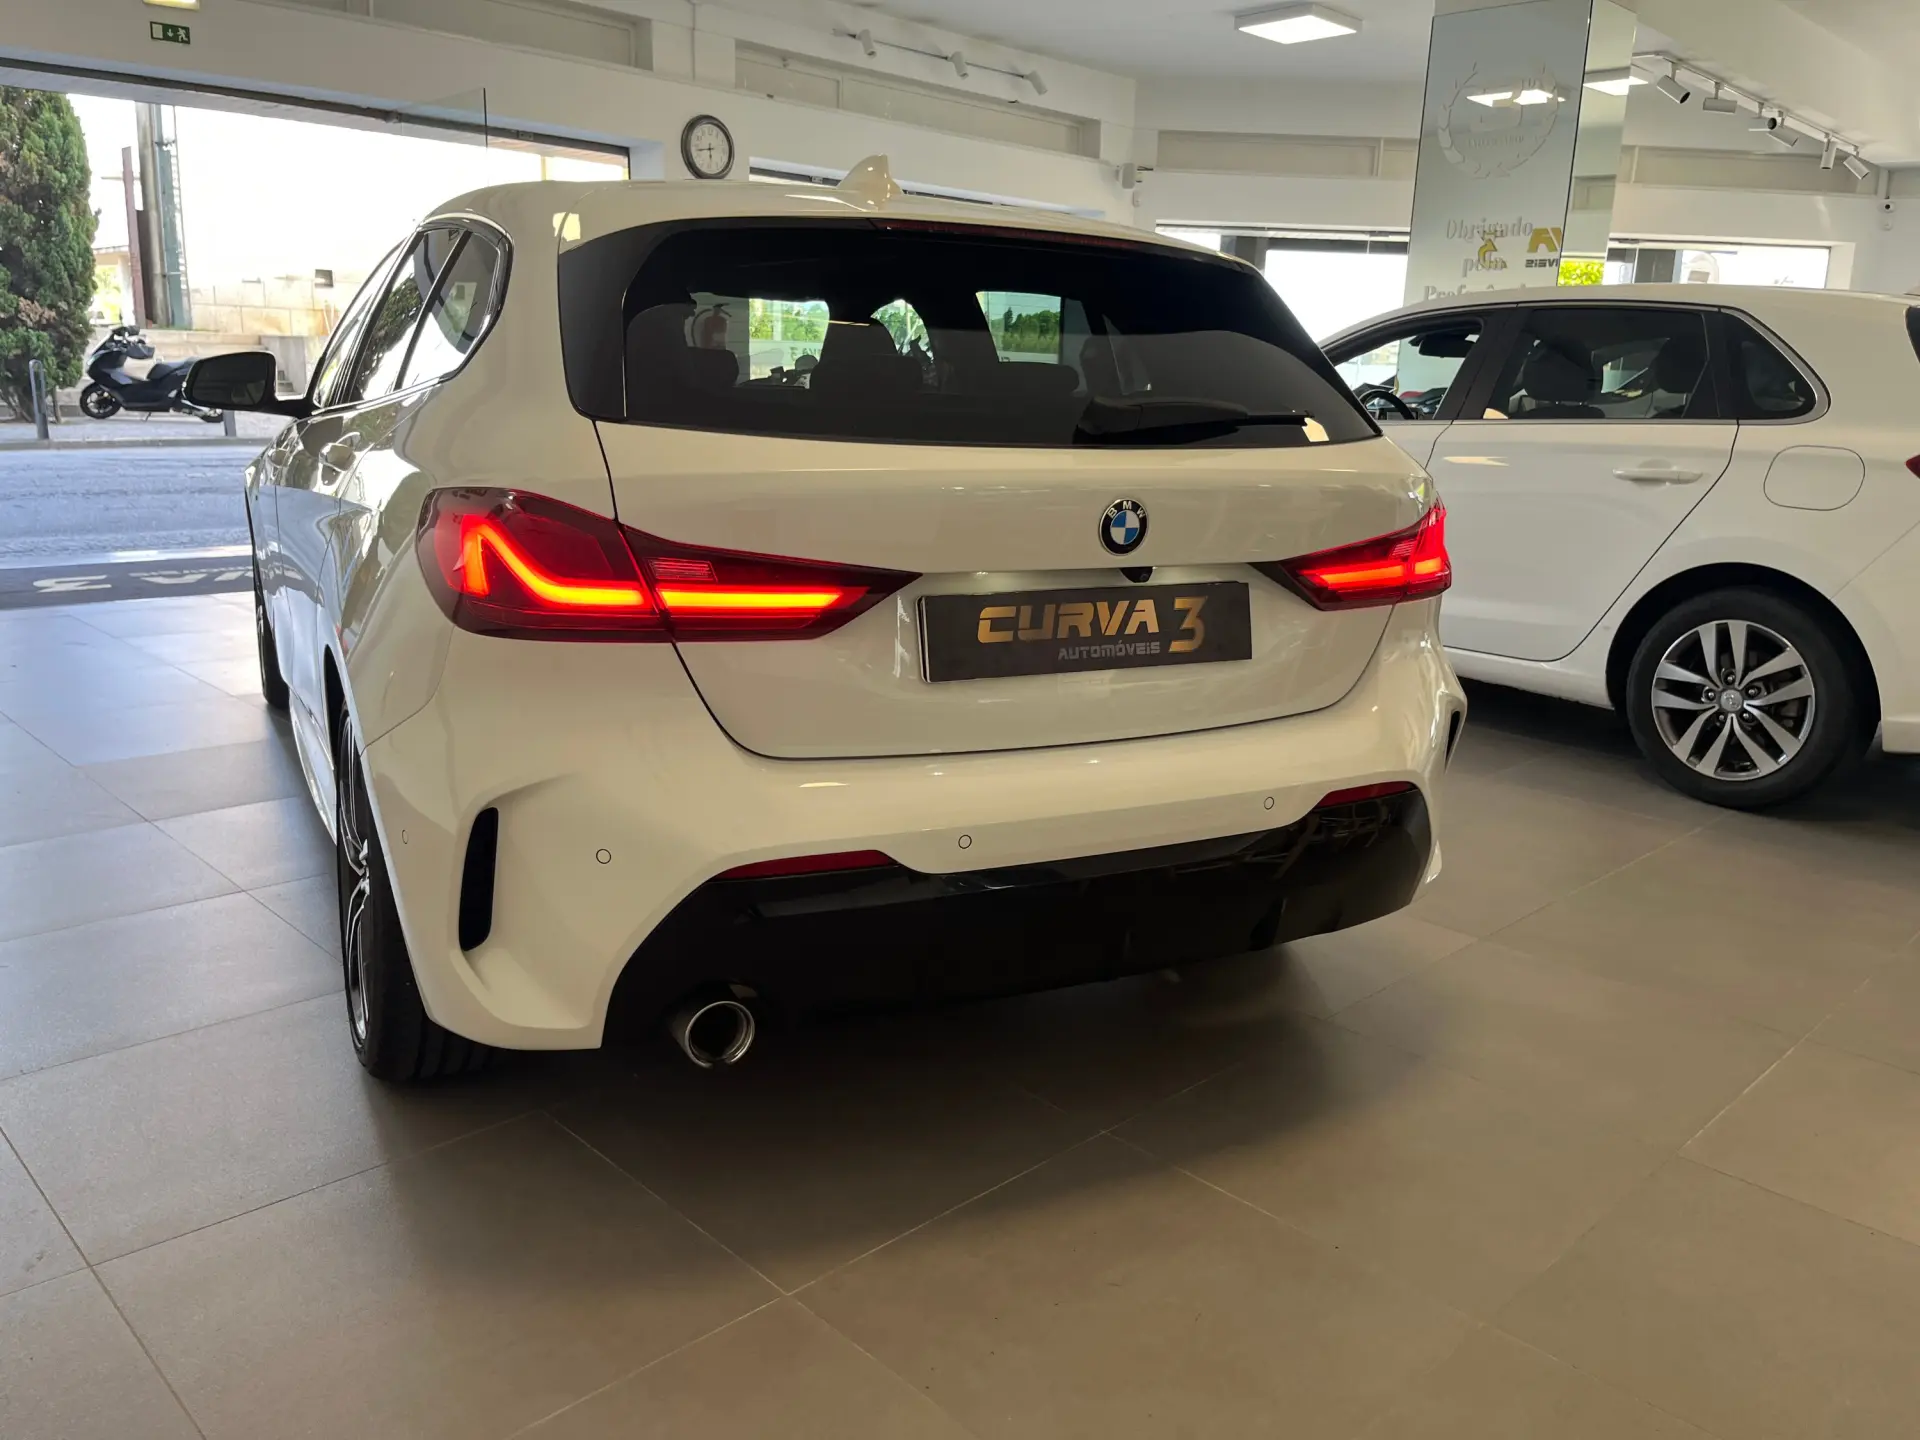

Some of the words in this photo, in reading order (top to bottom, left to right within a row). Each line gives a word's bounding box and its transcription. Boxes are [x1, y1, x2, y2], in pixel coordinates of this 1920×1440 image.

[1446, 216, 1533, 243] Obrigado
[1107, 500, 1146, 519] BMW
[977, 599, 1160, 644] CURVA
[1168, 596, 1208, 653] 3
